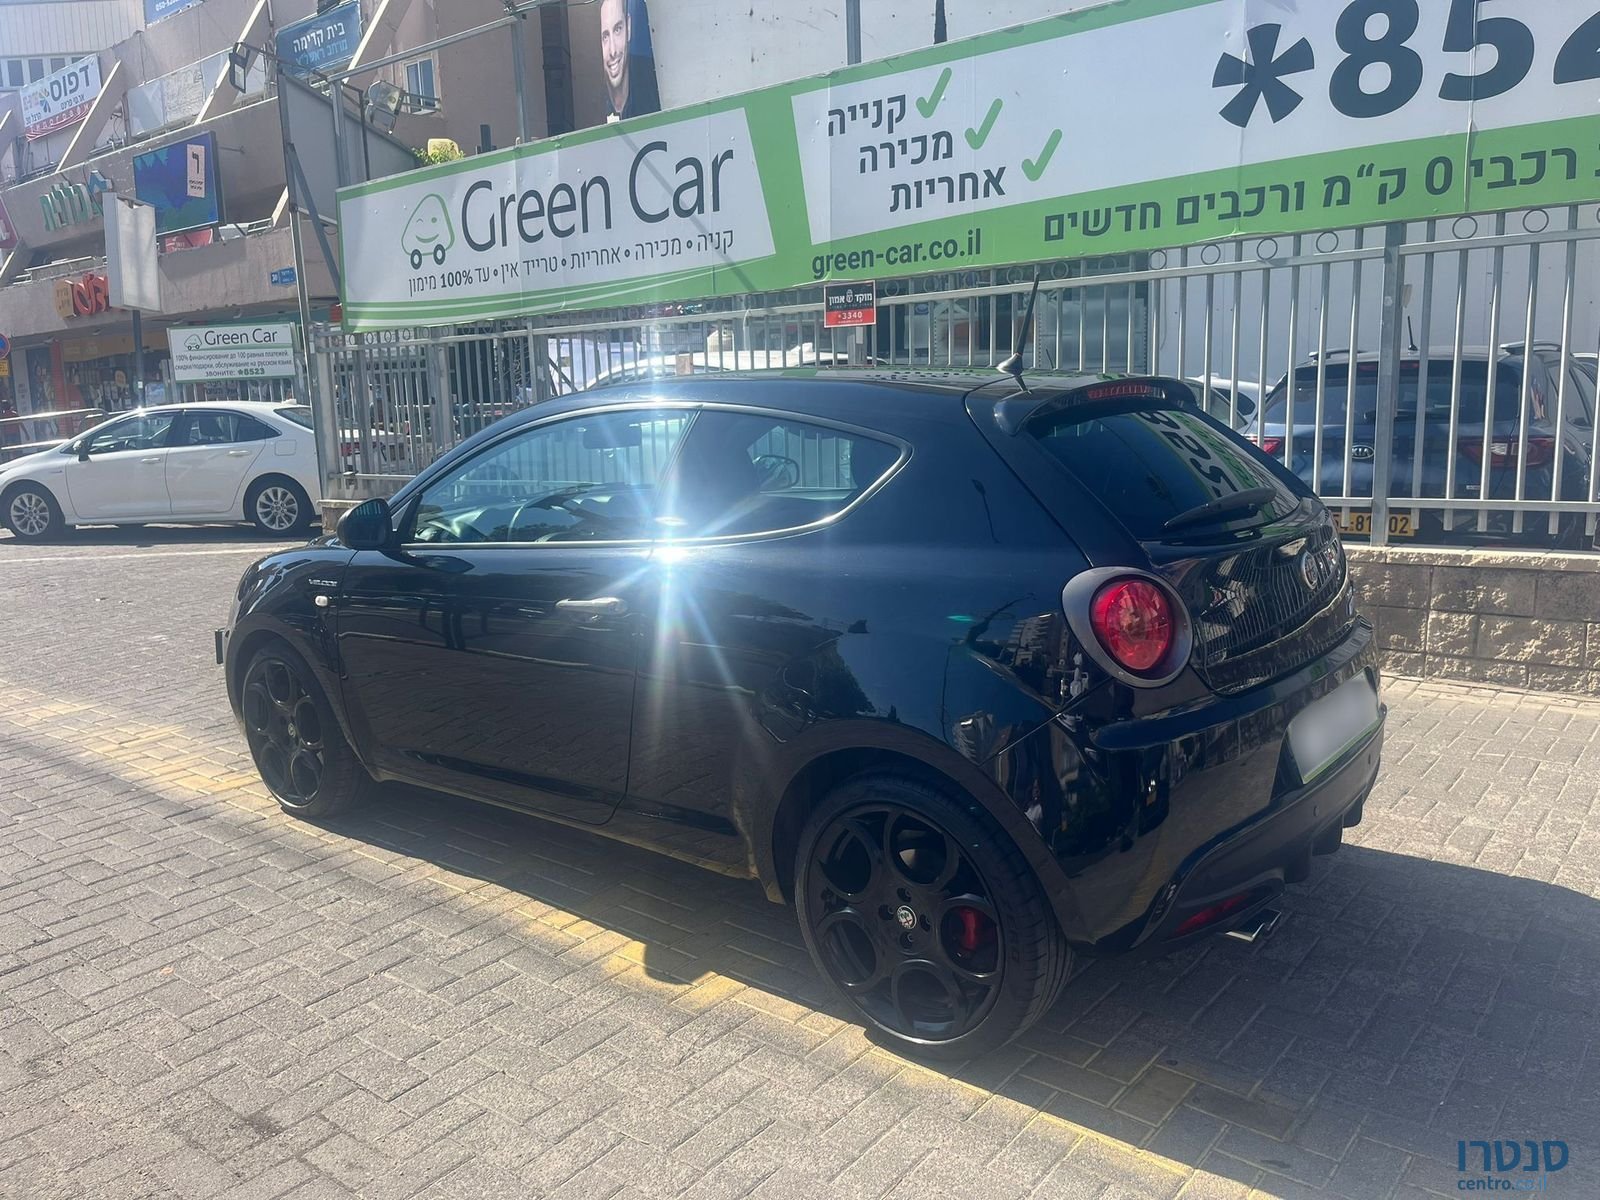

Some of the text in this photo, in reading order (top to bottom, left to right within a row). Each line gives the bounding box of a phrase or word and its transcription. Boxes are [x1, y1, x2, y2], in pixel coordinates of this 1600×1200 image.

[292, 22, 346, 53] בית קדימה
[50, 65, 90, 102] דפוס
[828, 94, 906, 136] קנייה
[859, 130, 953, 174] מכירה
[1469, 147, 1577, 189] רכבי
[889, 166, 1007, 212] אחריות
[1425, 156, 1453, 195] 0
[461, 141, 734, 253] Green Car
[1177, 180, 1305, 226] ורכבים
[1044, 201, 1161, 242] חדשים
[409, 229, 733, 297] קניה מכירה אחריות טרייד אין עד 100% מימון
[811, 229, 981, 280] green-car.co.il
[828, 293, 873, 306] מוקד אמון
[204, 328, 278, 346] Green Car
